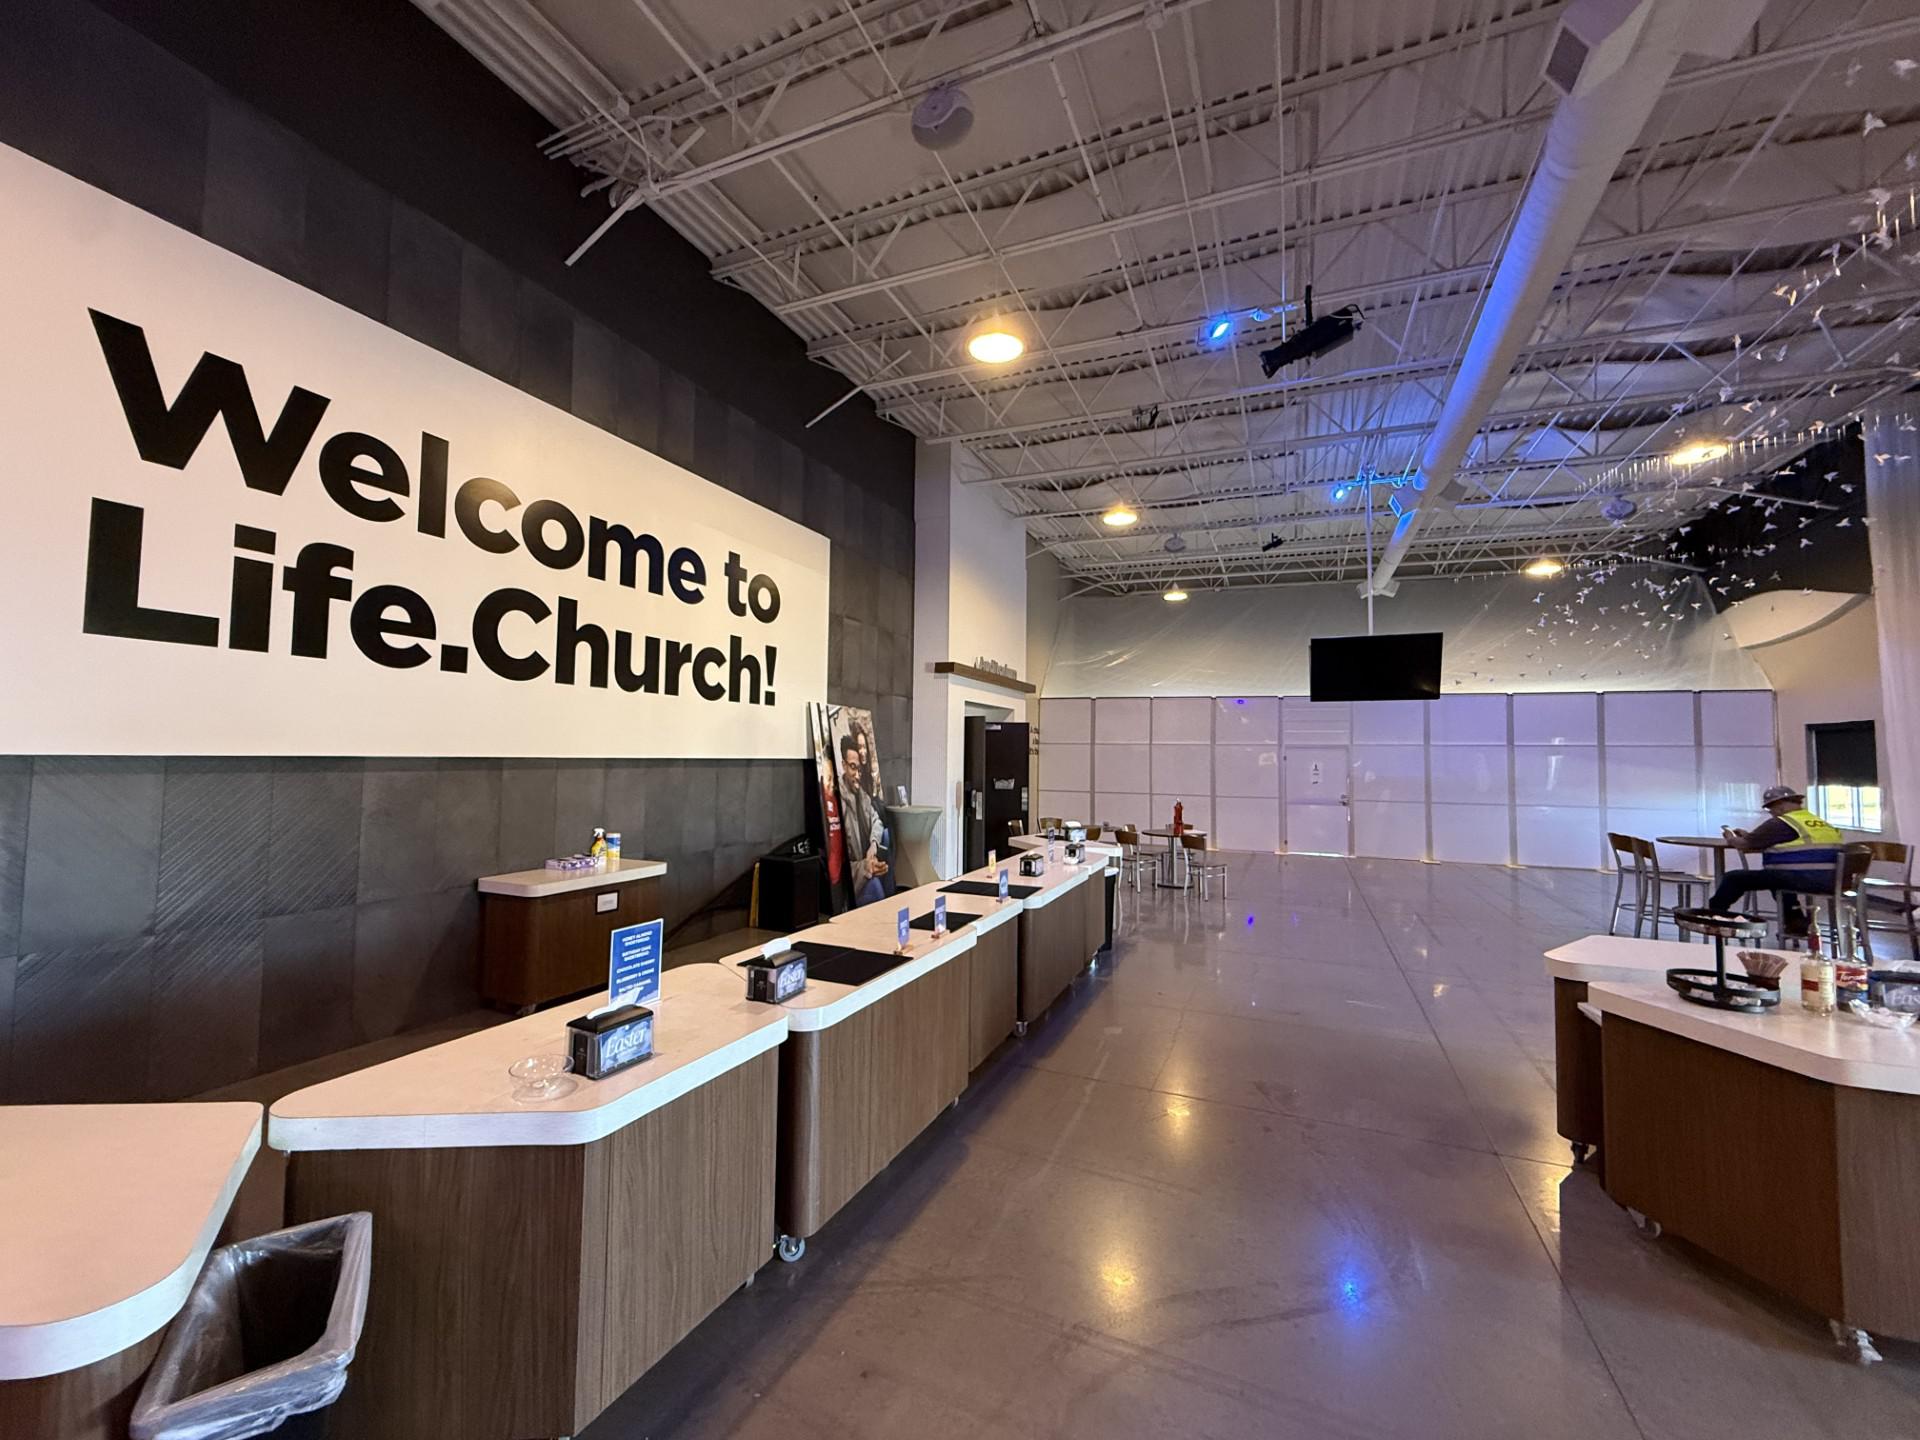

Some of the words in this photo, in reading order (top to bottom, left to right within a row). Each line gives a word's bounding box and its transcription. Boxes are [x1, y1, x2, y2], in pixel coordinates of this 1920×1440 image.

[88, 307, 706, 604] Welcome
[724, 551, 781, 624] to
[83, 497, 777, 706] Life.Church!
[606, 1028, 646, 1058] Easter
